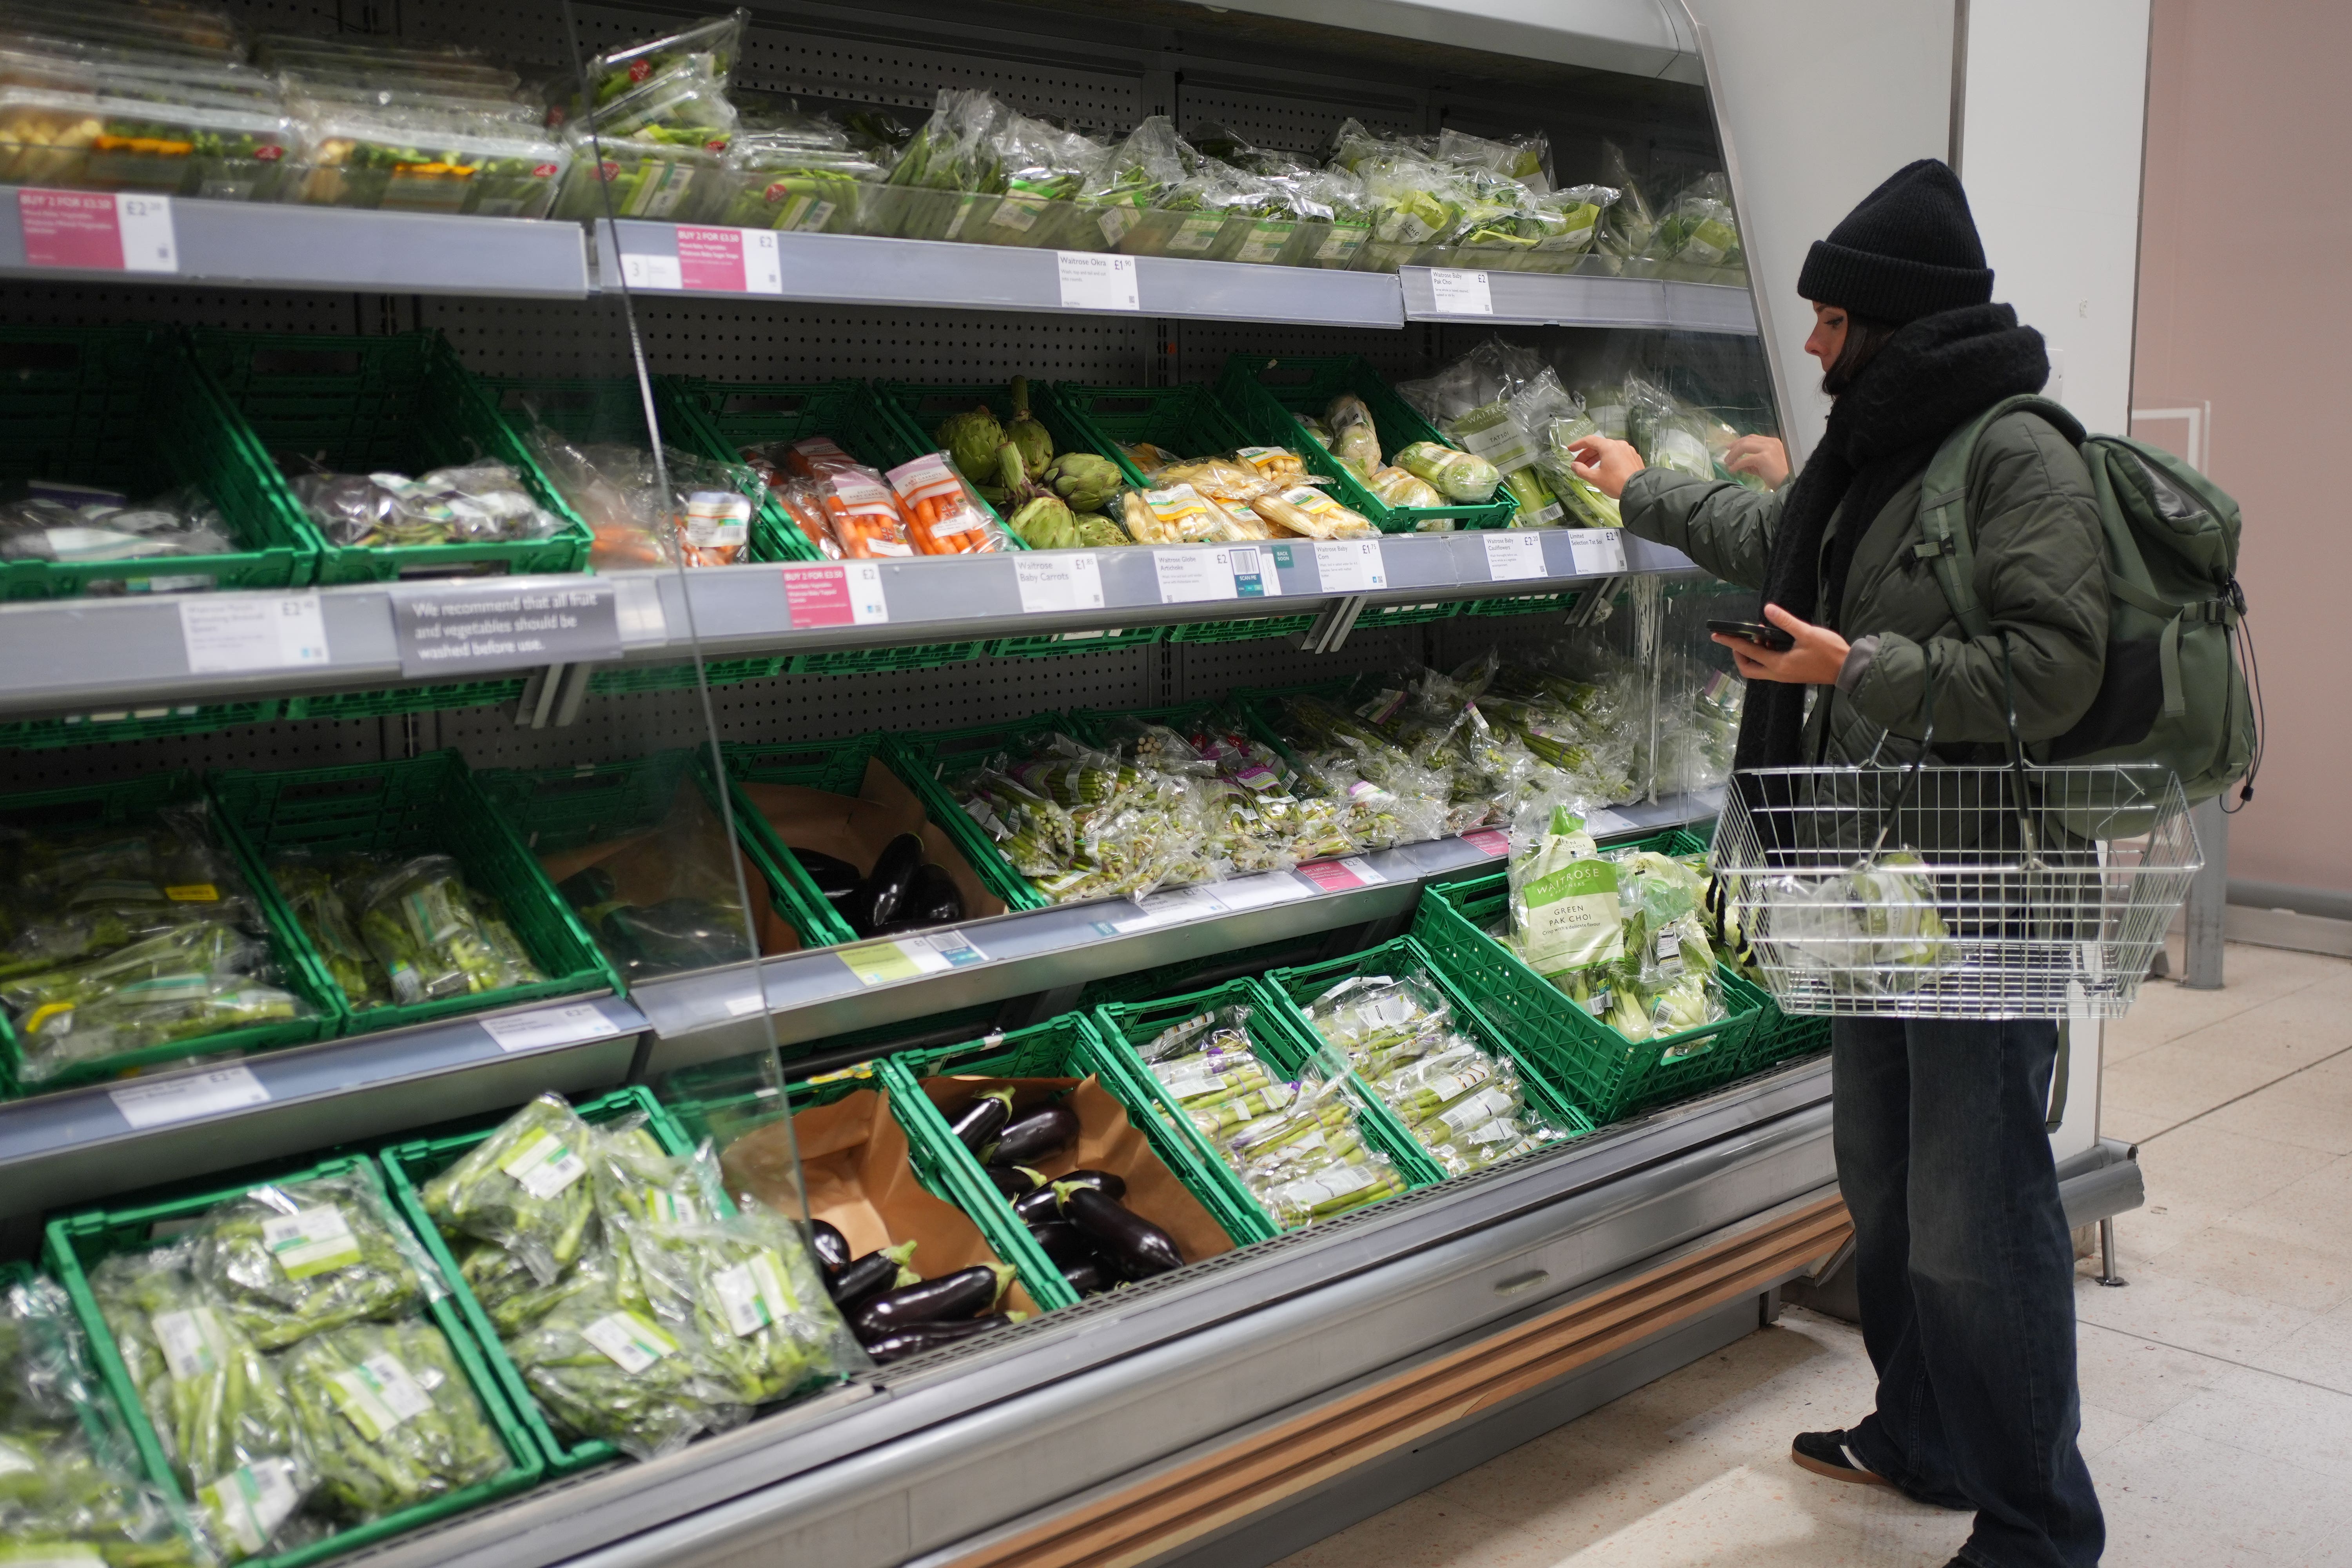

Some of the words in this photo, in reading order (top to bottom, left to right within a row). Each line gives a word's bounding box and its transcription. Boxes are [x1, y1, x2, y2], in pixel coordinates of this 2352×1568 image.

[57, 197, 80, 207] FOR
[1413, 195, 1443, 218] TROSE
[678, 230, 694, 240] BUY
[720, 234, 739, 243] £3.50
[760, 236, 772, 247] £2
[1060, 257, 1089, 265] Waitrose
[1115, 260, 1131, 270] £1.90
[1478, 274, 1486, 283] £2
[1468, 406, 1503, 423] WAITRO
[1490, 431, 1509, 442] TATSOI
[905, 479, 916, 487] BABY
[1524, 536, 1538, 545] £2.20
[1606, 532, 1618, 541] £2.10
[1362, 544, 1376, 554] £1.75
[1076, 559, 1094, 570] £1.85
[1217, 555, 1227, 564] £2
[785, 572, 801, 581] BUY
[809, 571, 823, 580] FOR
[825, 570, 843, 579] £3.50
[863, 569, 875, 579] £2
[1020, 574, 1038, 583] Baby
[413, 602, 438, 617] We
[442, 597, 520, 616] recommend
[523, 595, 548, 610] that
[552, 594, 565, 608] all
[570, 593, 597, 606] fruit
[415, 623, 441, 639] and
[443, 619, 512, 639] vegetables
[514, 616, 557, 632] should
[559, 614, 577, 628] be
[417, 642, 470, 659] washed
[472, 639, 515, 655] before
[518, 639, 544, 652] use.
[1239, 766, 1267, 778] WAITRO
[1537, 868, 1599, 895] WAITROSE
[1555, 882, 1585, 895] PARTNERS
[1554, 905, 1584, 915] GREEN
[1550, 917, 1566, 926] PAK
[1569, 914, 1592, 922] CHOI
